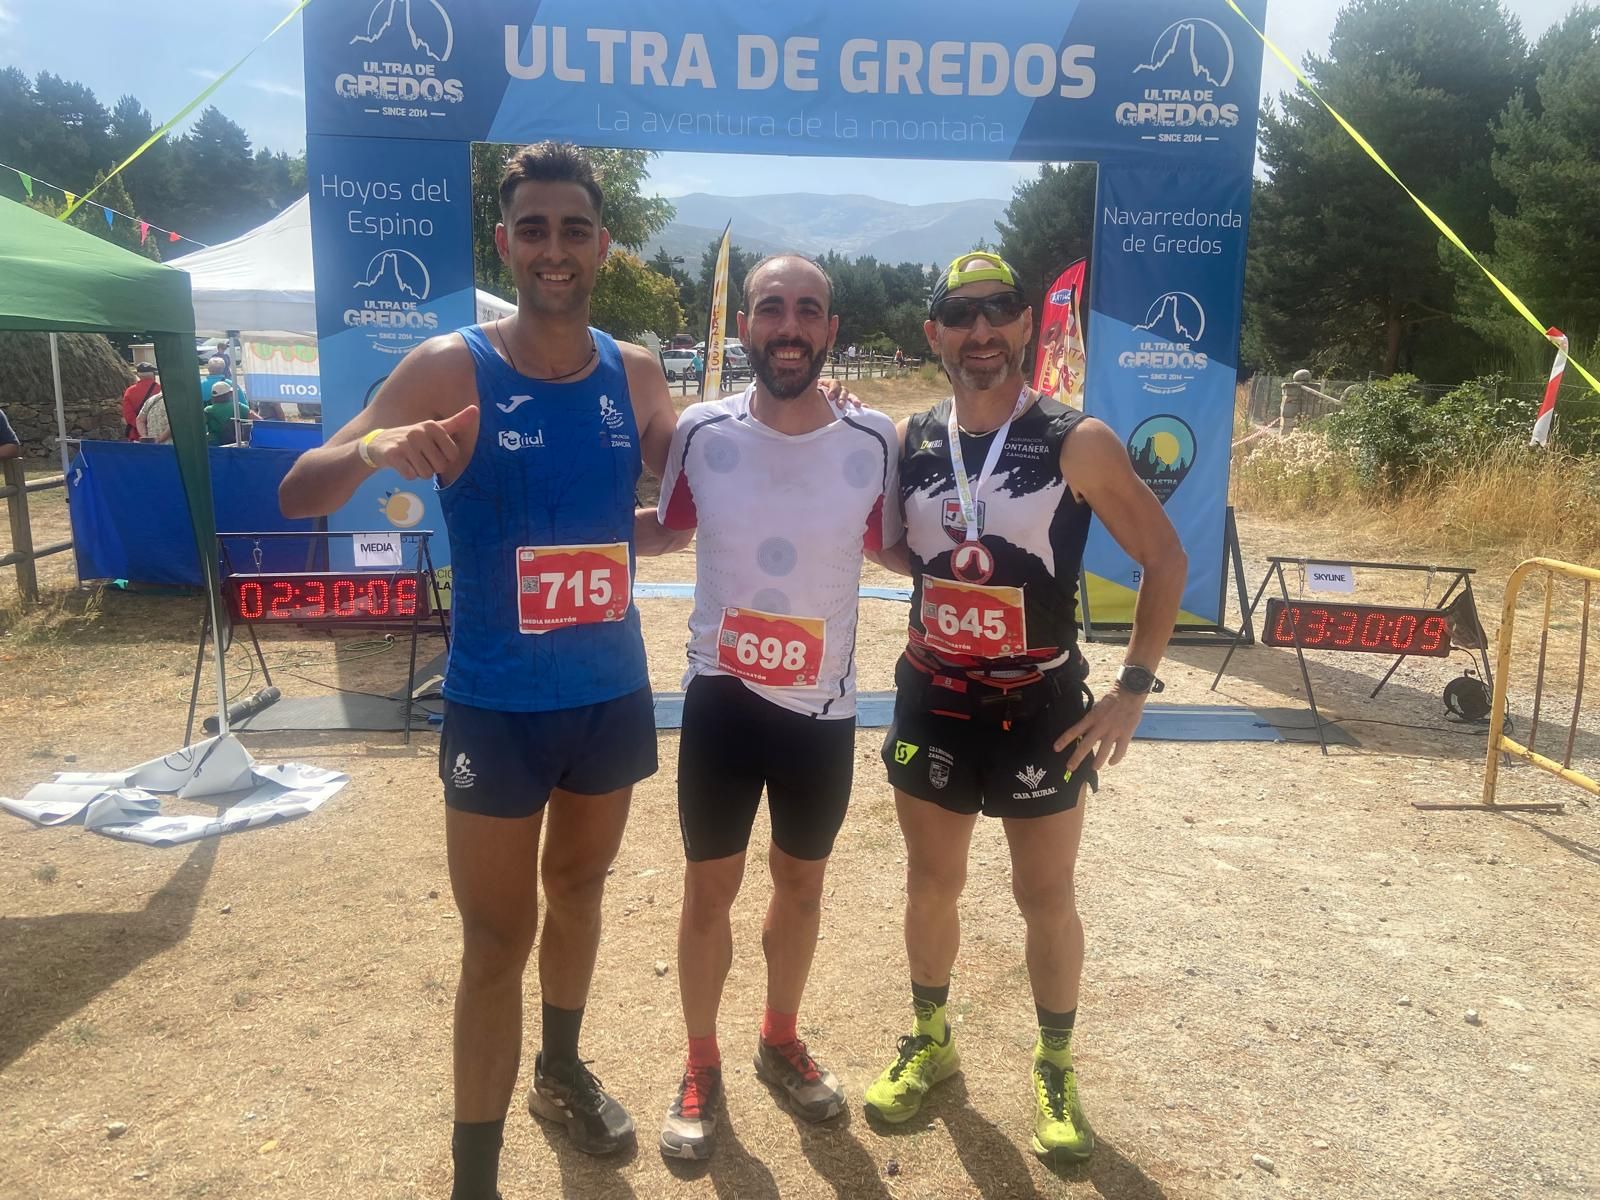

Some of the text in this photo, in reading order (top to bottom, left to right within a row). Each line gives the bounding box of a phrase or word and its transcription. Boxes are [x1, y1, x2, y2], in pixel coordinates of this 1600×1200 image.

[363, 61, 436, 77] ULTRA DE
[504, 25, 1096, 99] ULTRA DE GREDOS
[335, 73, 464, 103] GREDOS
[1144, 89, 1213, 102] ULTRA DE
[381, 106, 428, 118] SINCE 2014
[1115, 102, 1239, 128] GREDOS
[596, 103, 1005, 143] La aventura de la montaña
[1158, 133, 1202, 143] SINCE 2014
[321, 174, 451, 206] Hoyos del
[348, 210, 434, 241] Espino
[1103, 207, 1243, 229] Navarredonda
[1122, 233, 1222, 255] de Gredos
[364, 300, 417, 311] ULTRA DE
[343, 309, 439, 330] GREDOS
[1140, 342, 1191, 352] ULTRA DE
[1119, 351, 1208, 371] GREDOS
[1004, 442, 1050, 454] ONTAÑERA
[360, 542, 393, 553] MEDIA
[1313, 572, 1346, 583] SKYLINE
[540, 568, 612, 609] 715
[545, 616, 577, 624] MARATÓN
[937, 603, 1007, 640] 645
[1276, 608, 1446, 650] 03:30:09
[736, 632, 807, 671] 698
[1032, 786, 1058, 799] RURAL
